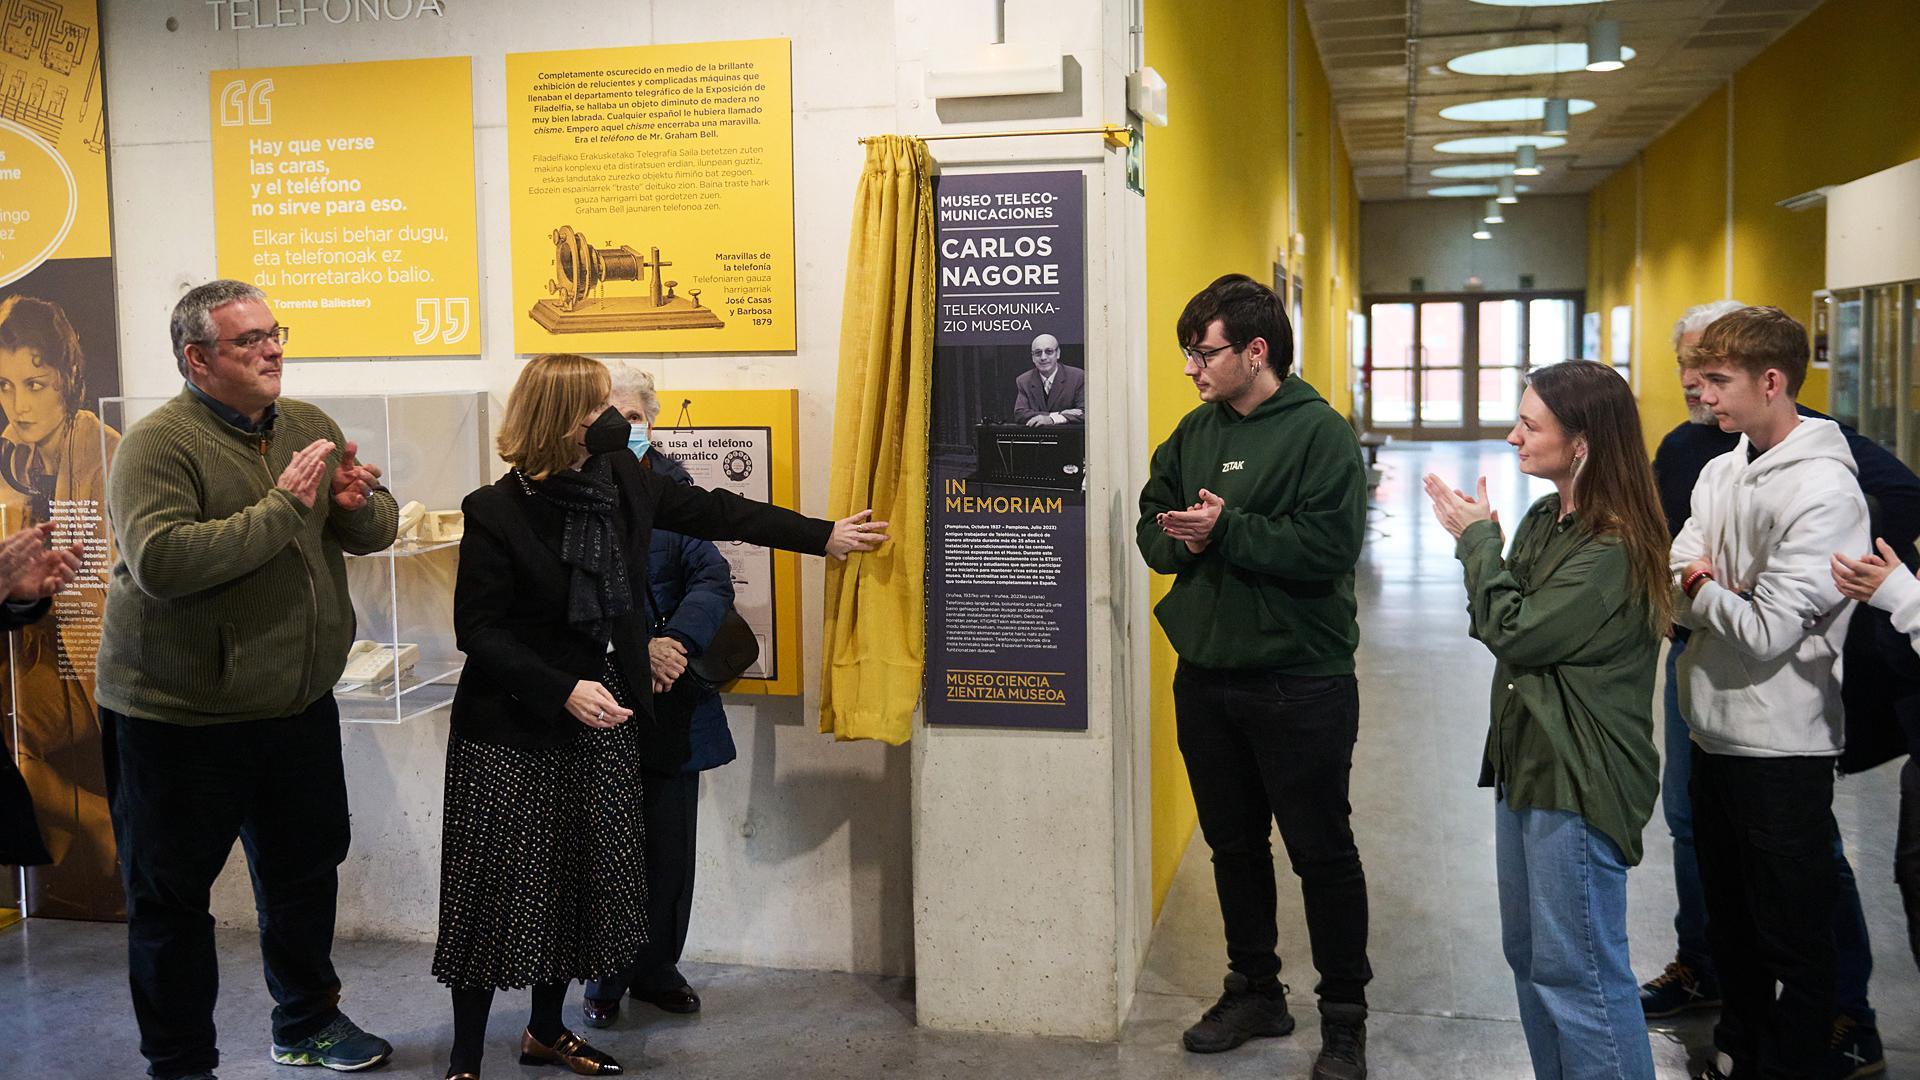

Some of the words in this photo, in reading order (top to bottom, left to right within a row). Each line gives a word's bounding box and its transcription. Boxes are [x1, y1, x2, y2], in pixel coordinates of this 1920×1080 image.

[205, 0, 443, 31] TELEFONOA
[537, 70, 604, 80] Completamente
[606, 67, 652, 76] oscurecido
[666, 64, 693, 73] medio
[718, 62, 753, 70] brillante
[533, 82, 575, 91] exhibición
[590, 79, 635, 88] relucientes
[644, 76, 697, 86] complicadas
[699, 74, 741, 83] máquinas
[742, 73, 759, 81] que
[528, 94, 562, 102] llenaban
[564, 92, 572, 100] el
[573, 91, 633, 100] departamento
[635, 87, 680, 97] telegráfico
[705, 84, 752, 94] Exposición
[754, 83, 765, 91] de
[534, 103, 574, 112] Filadelfia,
[587, 101, 617, 110] hallaba
[631, 99, 658, 109] objeto
[660, 98, 699, 106] diminuto
[714, 95, 746, 104] madera
[571, 113, 605, 121] labrada.
[606, 111, 646, 120] Cualquier
[648, 109, 681, 119] español
[693, 108, 725, 116] hubiera
[727, 106, 762, 114] llamado
[533, 126, 564, 134] chisme.
[566, 125, 599, 133] Empero
[601, 123, 624, 132] aquel
[625, 122, 655, 130] chisme
[657, 120, 699, 128] encerraba
[719, 117, 760, 126] maravilla.
[590, 135, 598, 143] el
[600, 134, 634, 142] teléfono
[664, 131, 698, 139] Graham
[700, 130, 718, 138] Bell.
[249, 138, 283, 157] Hay
[287, 139, 322, 156] que
[326, 137, 375, 151] verse
[249, 159, 275, 175] las
[277, 160, 330, 175] caras,
[250, 183, 262, 199] y
[265, 178, 282, 195] el
[286, 177, 362, 194] teléfono
[939, 194, 991, 207] MUSEO
[994, 192, 1058, 205] TELECO-
[251, 203, 274, 216] no
[278, 198, 321, 215] sirve
[325, 200, 366, 217] para
[370, 198, 407, 212] eso.
[940, 206, 1053, 221] MUNICACIONES
[252, 229, 295, 246] Elkar
[300, 227, 338, 244] ikusi
[342, 226, 393, 243] behar
[397, 224, 448, 244] dugu,
[941, 235, 1052, 259] CARLOS
[252, 249, 283, 265] eta
[282, 246, 379, 265] telefonoak
[381, 250, 403, 262] ez
[715, 252, 757, 260] Maravillas
[759, 251, 771, 259] de
[733, 262, 771, 271] telefonía
[253, 270, 277, 286] du
[280, 266, 385, 285] horretarako
[384, 266, 434, 283] balio.
[692, 274, 744, 283] Telefoniaren
[745, 275, 771, 283] gauza
[942, 264, 1059, 287] NAGORE
[723, 284, 771, 294] harrigarriak
[272, 298, 318, 309] Torrente
[319, 297, 372, 309] Ballester)
[725, 296, 745, 304] José
[747, 296, 772, 304] Casas
[737, 307, 772, 315] Barbosa
[943, 302, 1060, 316] TELEKOMUNIKA-
[752, 318, 772, 326] 1879
[943, 320, 967, 332] ZIO
[971, 319, 1032, 331] MUSEOA
[651, 440, 663, 448] se
[668, 440, 688, 448] usa
[693, 438, 703, 448] el
[708, 438, 753, 448] teléfono
[1222, 461, 1244, 472] ZITAK
[945, 478, 966, 495] IN
[946, 496, 1062, 513] MEMORIAM
[946, 673, 994, 686] MUSEO
[995, 675, 1049, 687] CIENCIA
[946, 686, 1005, 698] ZIENTZIA
[1008, 688, 1065, 700] MUSEOA
